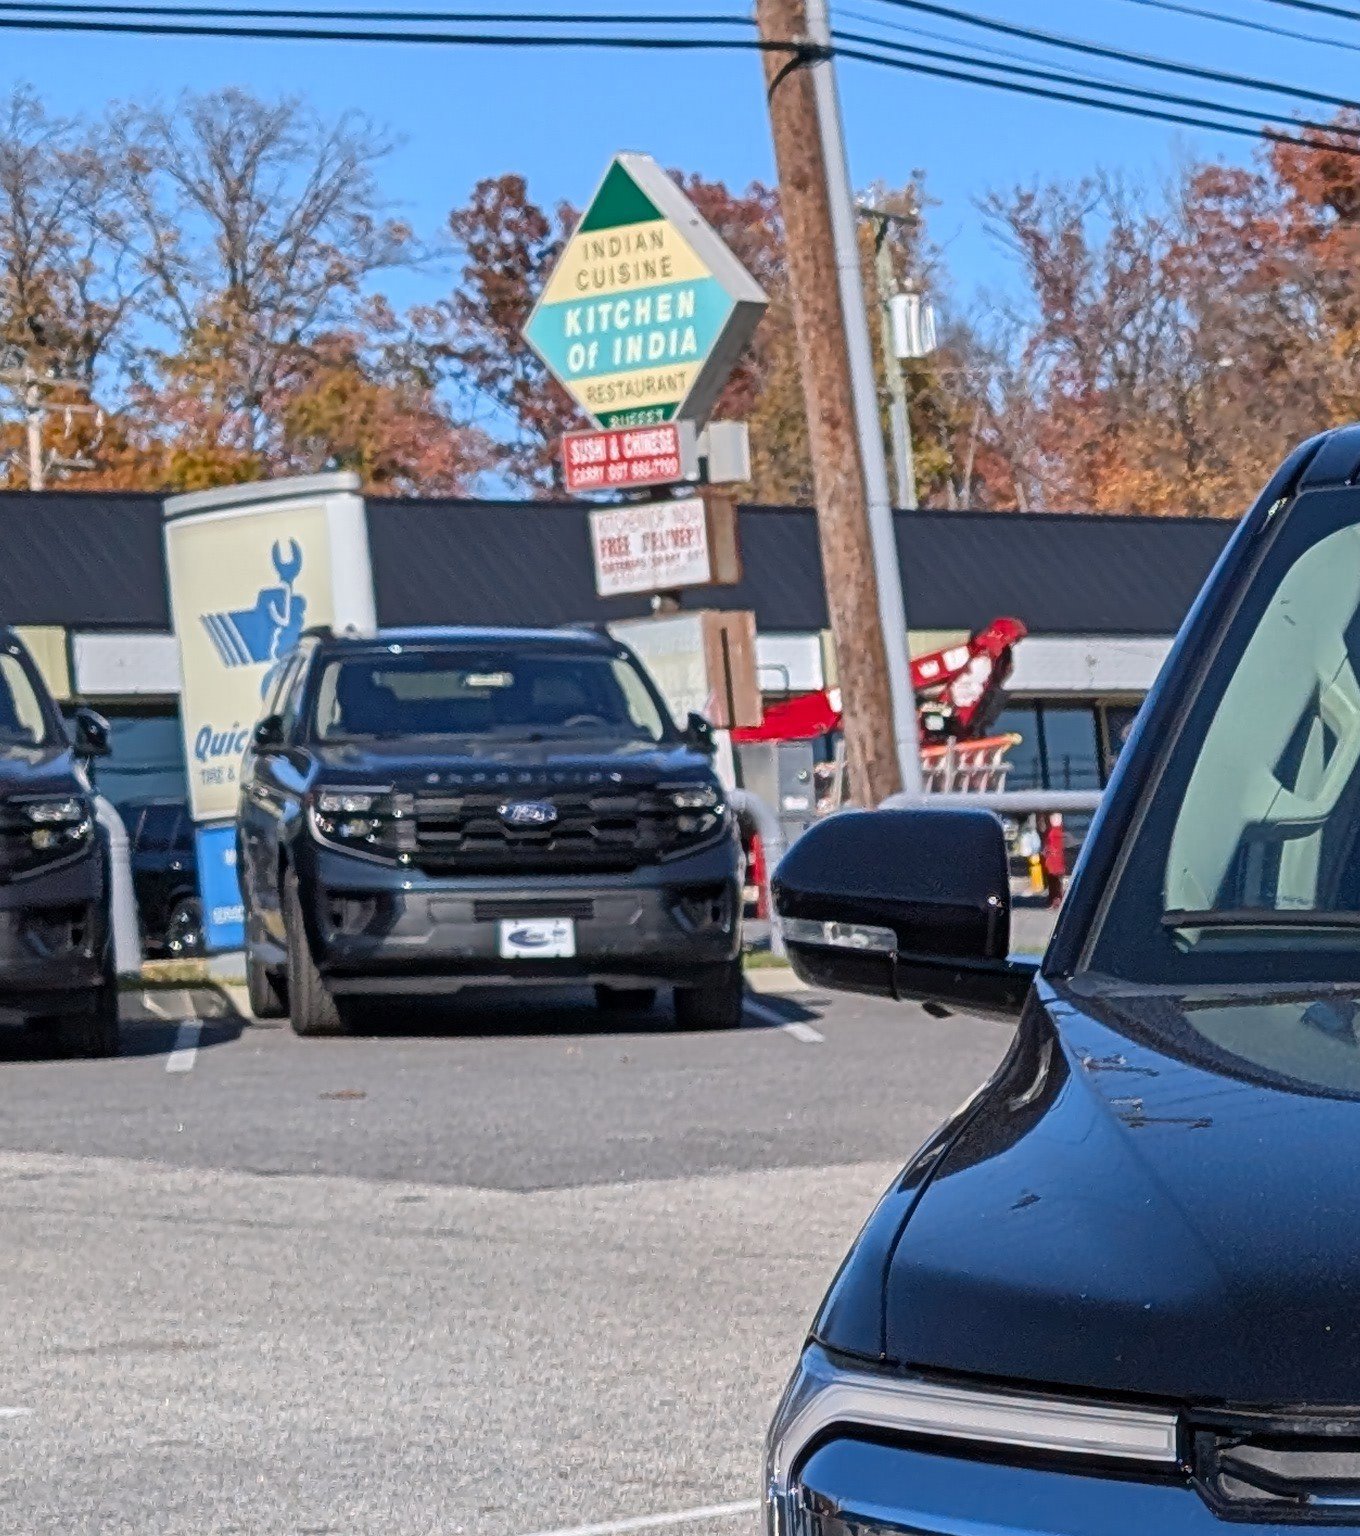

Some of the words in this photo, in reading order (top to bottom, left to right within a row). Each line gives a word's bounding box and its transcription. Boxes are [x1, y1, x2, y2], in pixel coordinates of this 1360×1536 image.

[583, 229, 664, 261] INDIAN
[575, 255, 673, 292] CUISINE
[564, 289, 695, 338] KITCHEN
[612, 326, 697, 366] INDIA
[586, 371, 687, 404] RESTAURANT
[570, 436, 607, 465] SUSHI
[622, 428, 676, 458] CHINESE
[194, 721, 249, 762] Quic
